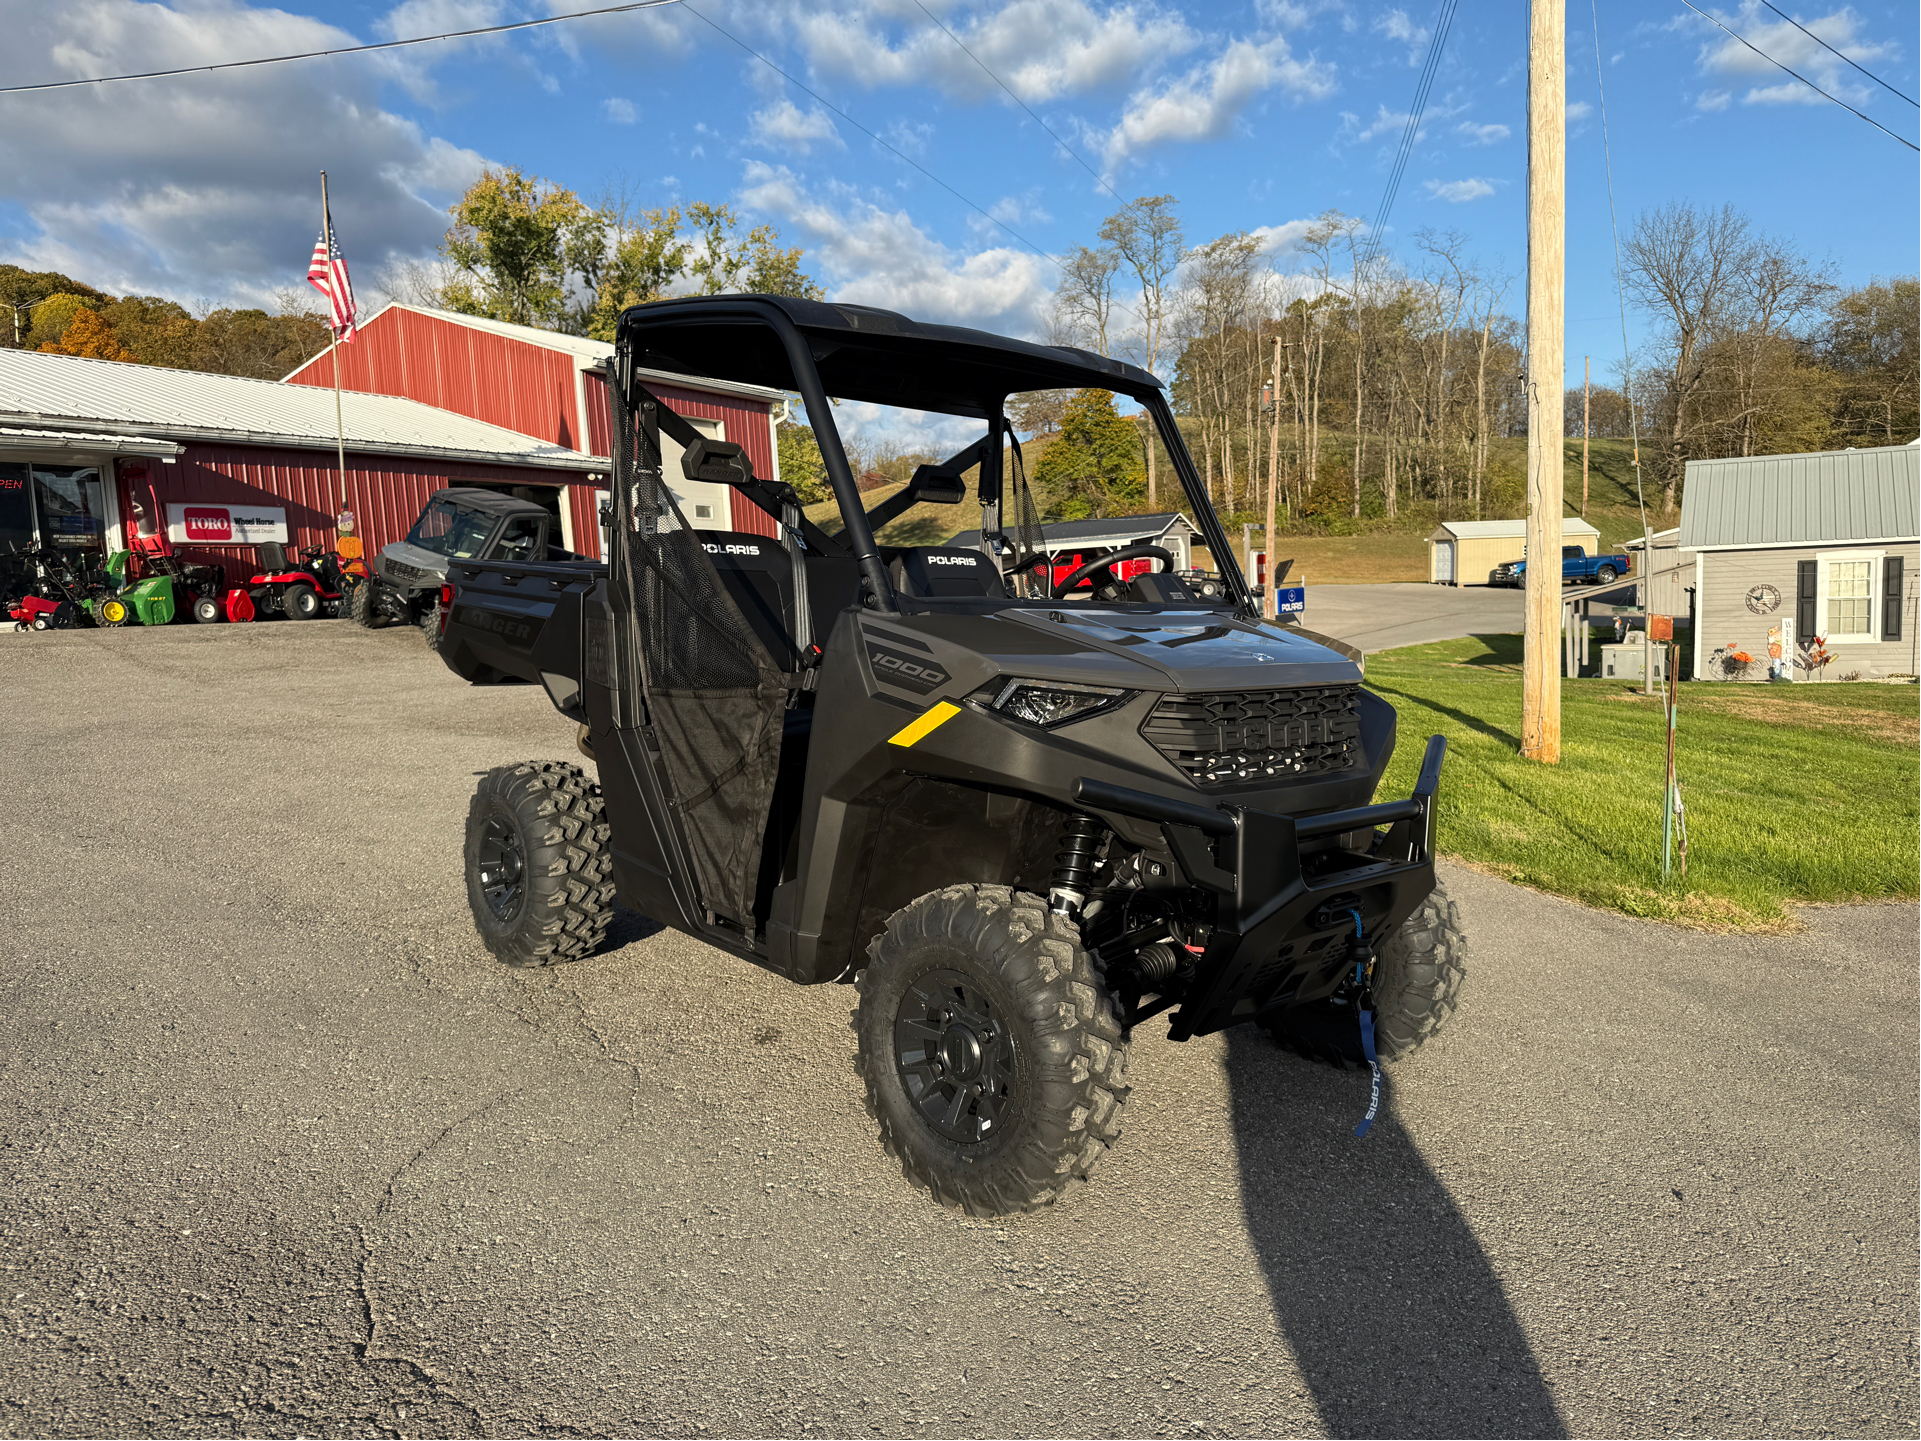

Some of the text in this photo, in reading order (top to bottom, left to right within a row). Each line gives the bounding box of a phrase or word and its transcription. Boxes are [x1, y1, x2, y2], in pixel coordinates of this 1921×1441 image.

[187, 517, 229, 530] TORO
[233, 517, 275, 526] Wheel Horse
[927, 555, 977, 566] POLARIS
[1281, 601, 1304, 612] POLARIS
[458, 608, 531, 639] RANGER
[872, 652, 945, 683] 1000
[1219, 716, 1361, 752] POLARIS
[1365, 1060, 1381, 1120] POLARIS
